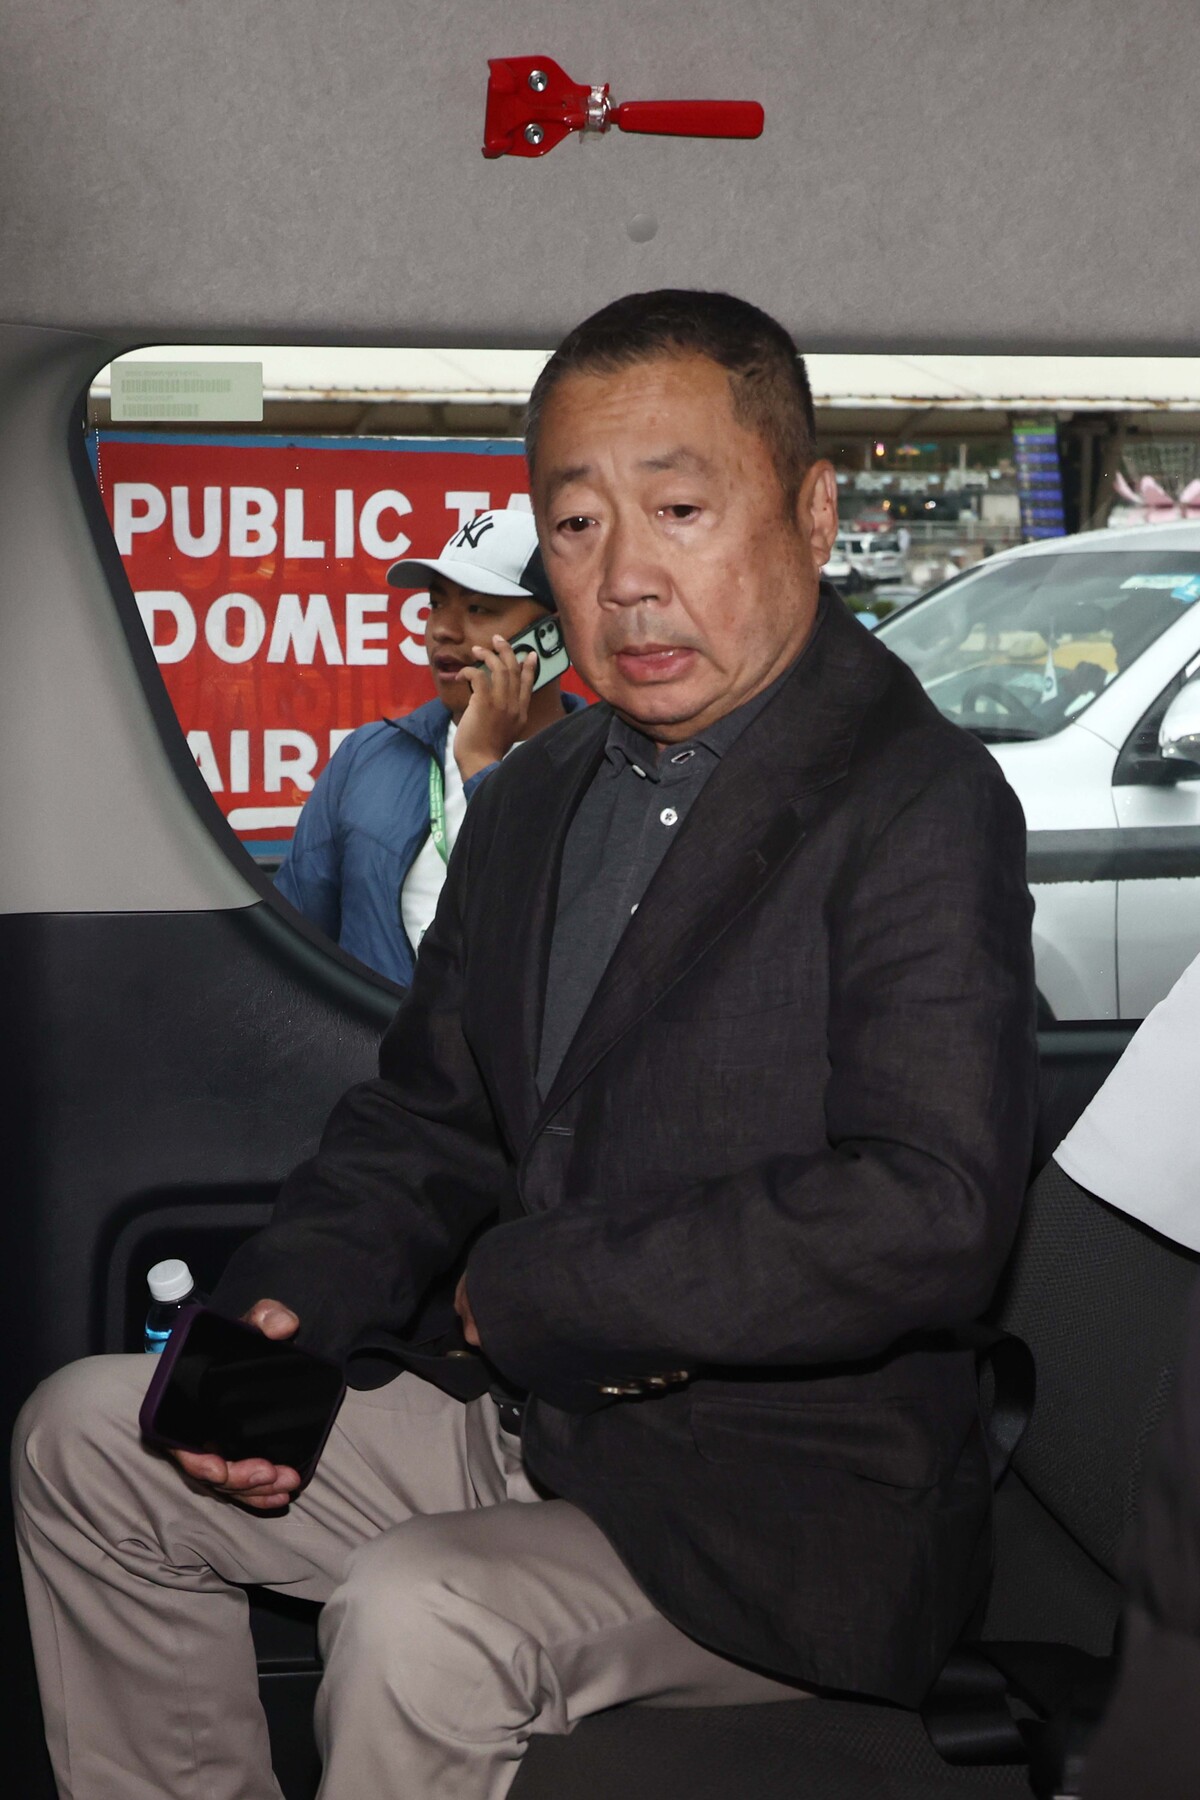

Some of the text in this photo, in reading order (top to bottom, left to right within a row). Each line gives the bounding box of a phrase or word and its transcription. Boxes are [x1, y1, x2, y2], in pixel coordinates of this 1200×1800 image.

[113, 482, 534, 560] PUBLIC T
[186, 729, 357, 793] AIR
